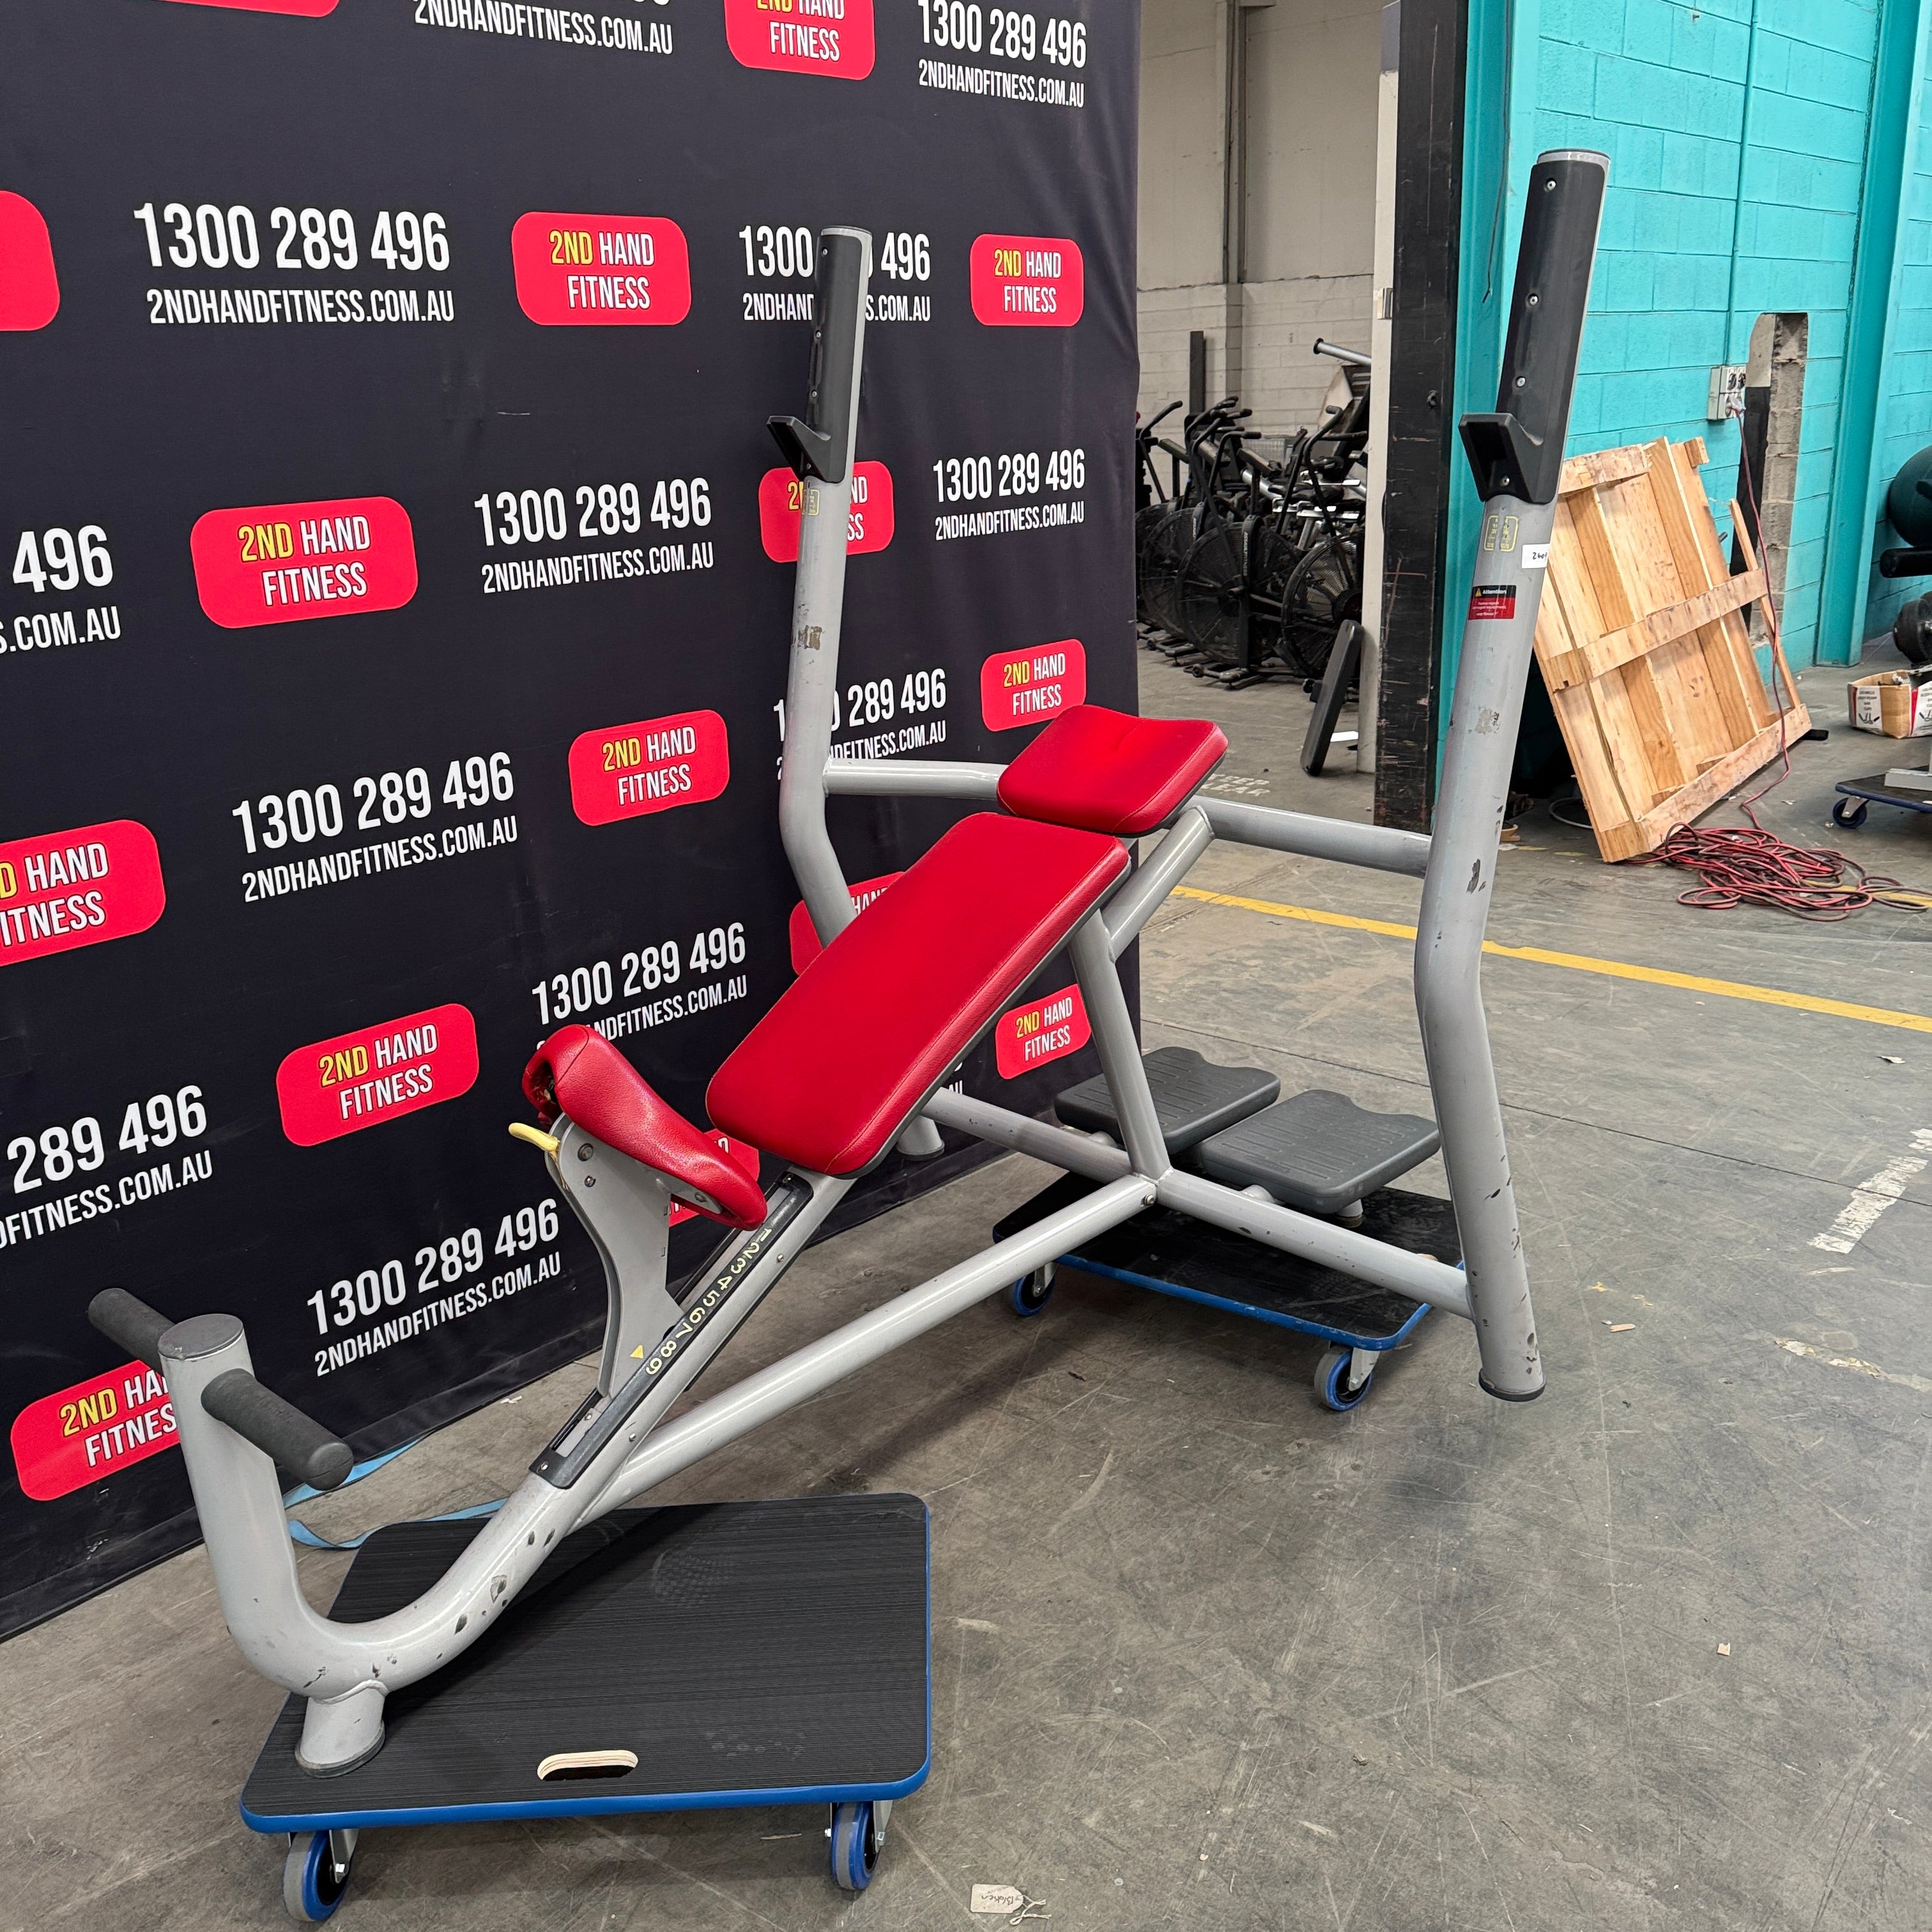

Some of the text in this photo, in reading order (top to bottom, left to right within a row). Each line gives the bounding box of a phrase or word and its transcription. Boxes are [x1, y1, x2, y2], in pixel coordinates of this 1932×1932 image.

[414, 0, 673, 55] 2NDHANDFITNESS.COM.AU
[769, 21, 840, 62] FITNESS
[917, 0, 1086, 68] 1300 289 496
[919, 59, 1085, 108] 2NDHANDFITNESS.COM.AU
[134, 202, 450, 272] 1300 289 496
[550, 230, 655, 266] 2ND HAND
[739, 225, 814, 277] 1300
[880, 232, 931, 281] 496
[994, 249, 1062, 279] 2ND HAND
[146, 289, 455, 324] 2NDHANDFITNESS.COM.AU
[569, 275, 651, 310] FITNESS
[1004, 286, 1057, 314] FITNESS
[933, 448, 1085, 503] 1300 289 496
[474, 477, 711, 547] 1300 289 496
[935, 501, 1085, 540] 2NDHANDFITNESS.COM.AU
[13, 525, 113, 593] 496
[238, 516, 371, 562] 2ND HAND
[262, 562, 368, 606] FITNESS
[481, 542, 714, 594] 2NDHANDFITNESS.COM.AU
[1003, 652, 1066, 688] 2ND HAND
[848, 678, 894, 727] 289
[900, 668, 946, 714] 496
[1011, 684, 1062, 717] FITNESS
[602, 727, 696, 773] 2ND HAND
[232, 751, 514, 854] 1300 289 496
[618, 764, 691, 806] FITNESS
[24, 843, 109, 892] HAND
[241, 815, 518, 903] 2NDHANDFITNESS.COM.AU
[532, 922, 746, 1025] 1300 289 496
[1016, 996, 1073, 1039] 2ND HAND
[319, 1024, 438, 1087] 2ND HAND
[1024, 1024, 1071, 1062] FITNESS
[339, 1064, 433, 1119] FITNESS
[7, 1085, 207, 1194] 289 496
[307, 1198, 559, 1335] 1300 289 496
[314, 1252, 562, 1377] 2NDHANDFITNESS.COM.AU
[59, 1388, 118, 1437] 2ND
[85, 1403, 178, 1468] FITNES
